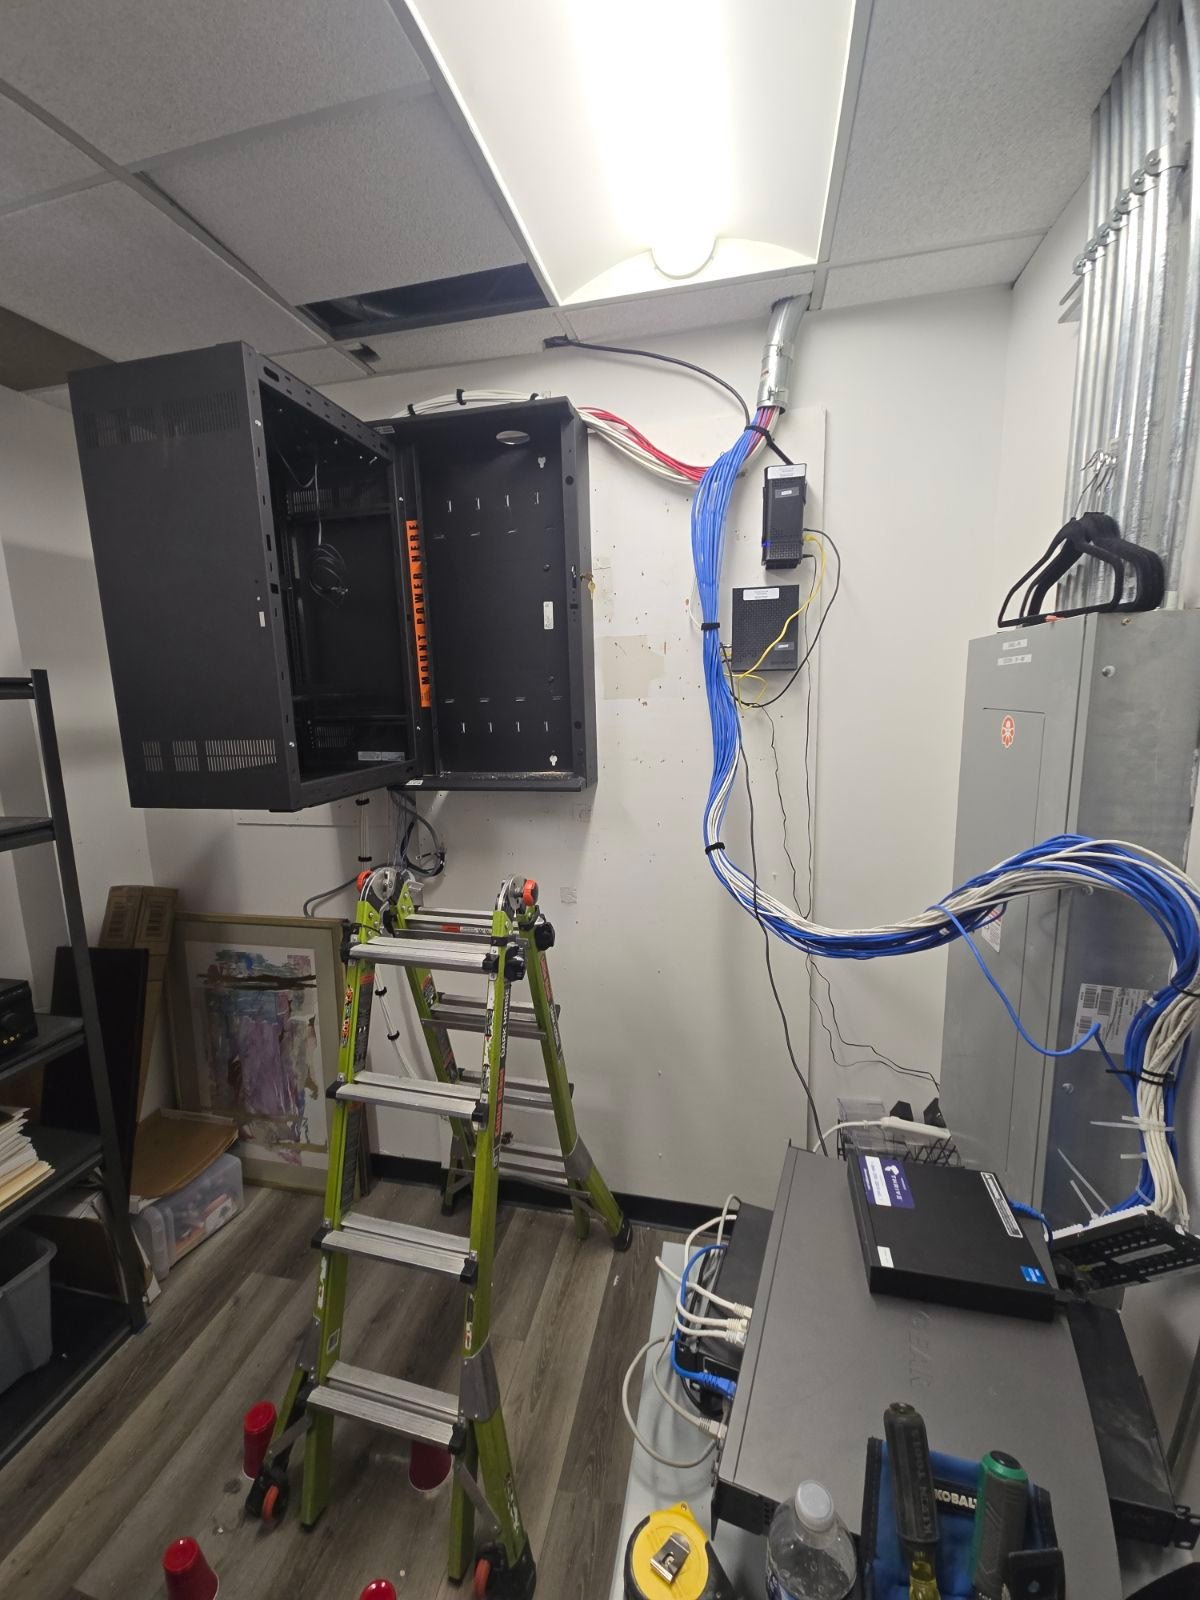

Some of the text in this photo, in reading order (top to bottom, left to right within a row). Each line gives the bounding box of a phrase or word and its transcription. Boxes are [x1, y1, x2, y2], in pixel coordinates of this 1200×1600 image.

[409, 524, 420, 562] HERE
[413, 573, 425, 625] POWER
[418, 634, 430, 685] MOUNT
[500, 1025, 508, 1058] DARK
